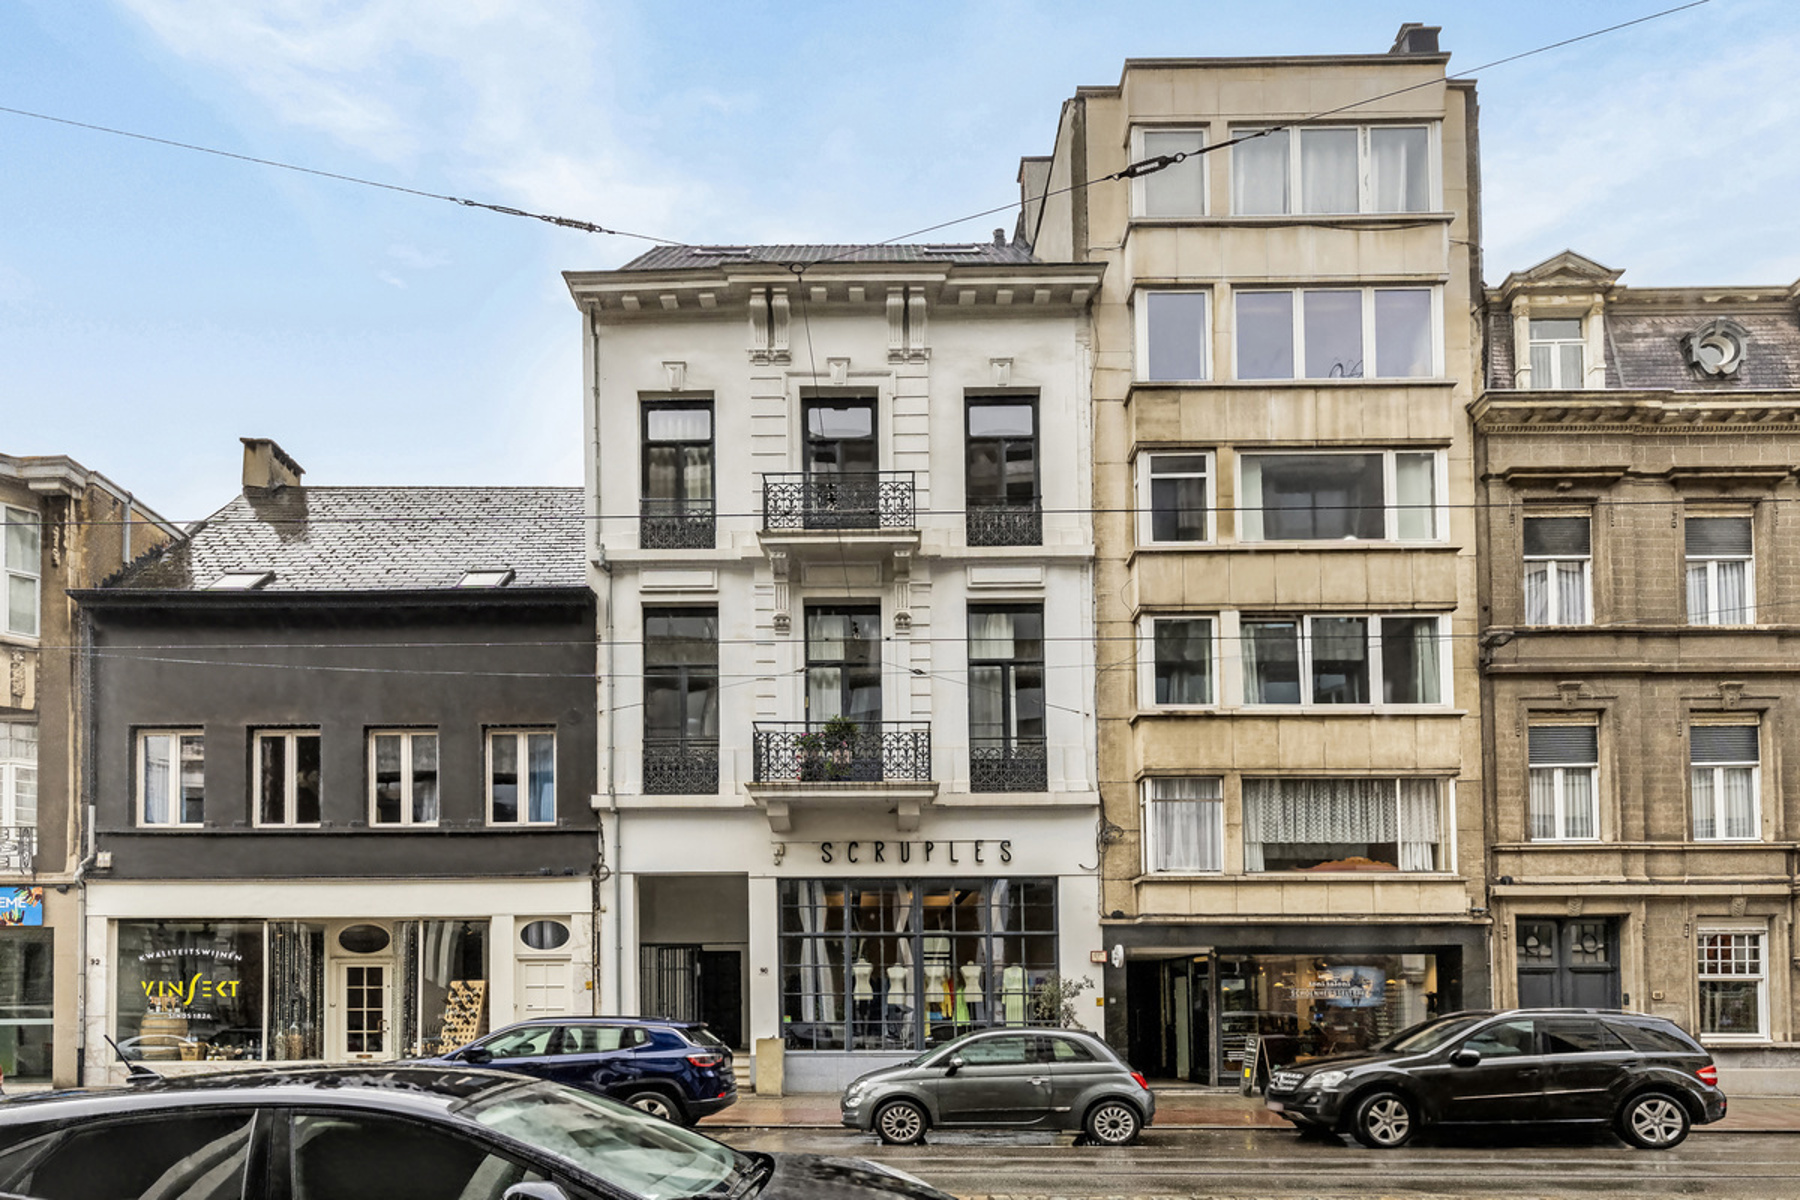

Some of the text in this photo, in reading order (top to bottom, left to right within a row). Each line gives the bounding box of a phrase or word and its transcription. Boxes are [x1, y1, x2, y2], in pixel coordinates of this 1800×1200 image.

[821, 840, 1012, 863] SCRUPLES
[138, 947, 243, 962] KWALITEITSWIJNEN
[140, 973, 240, 1005] VINSEKT
